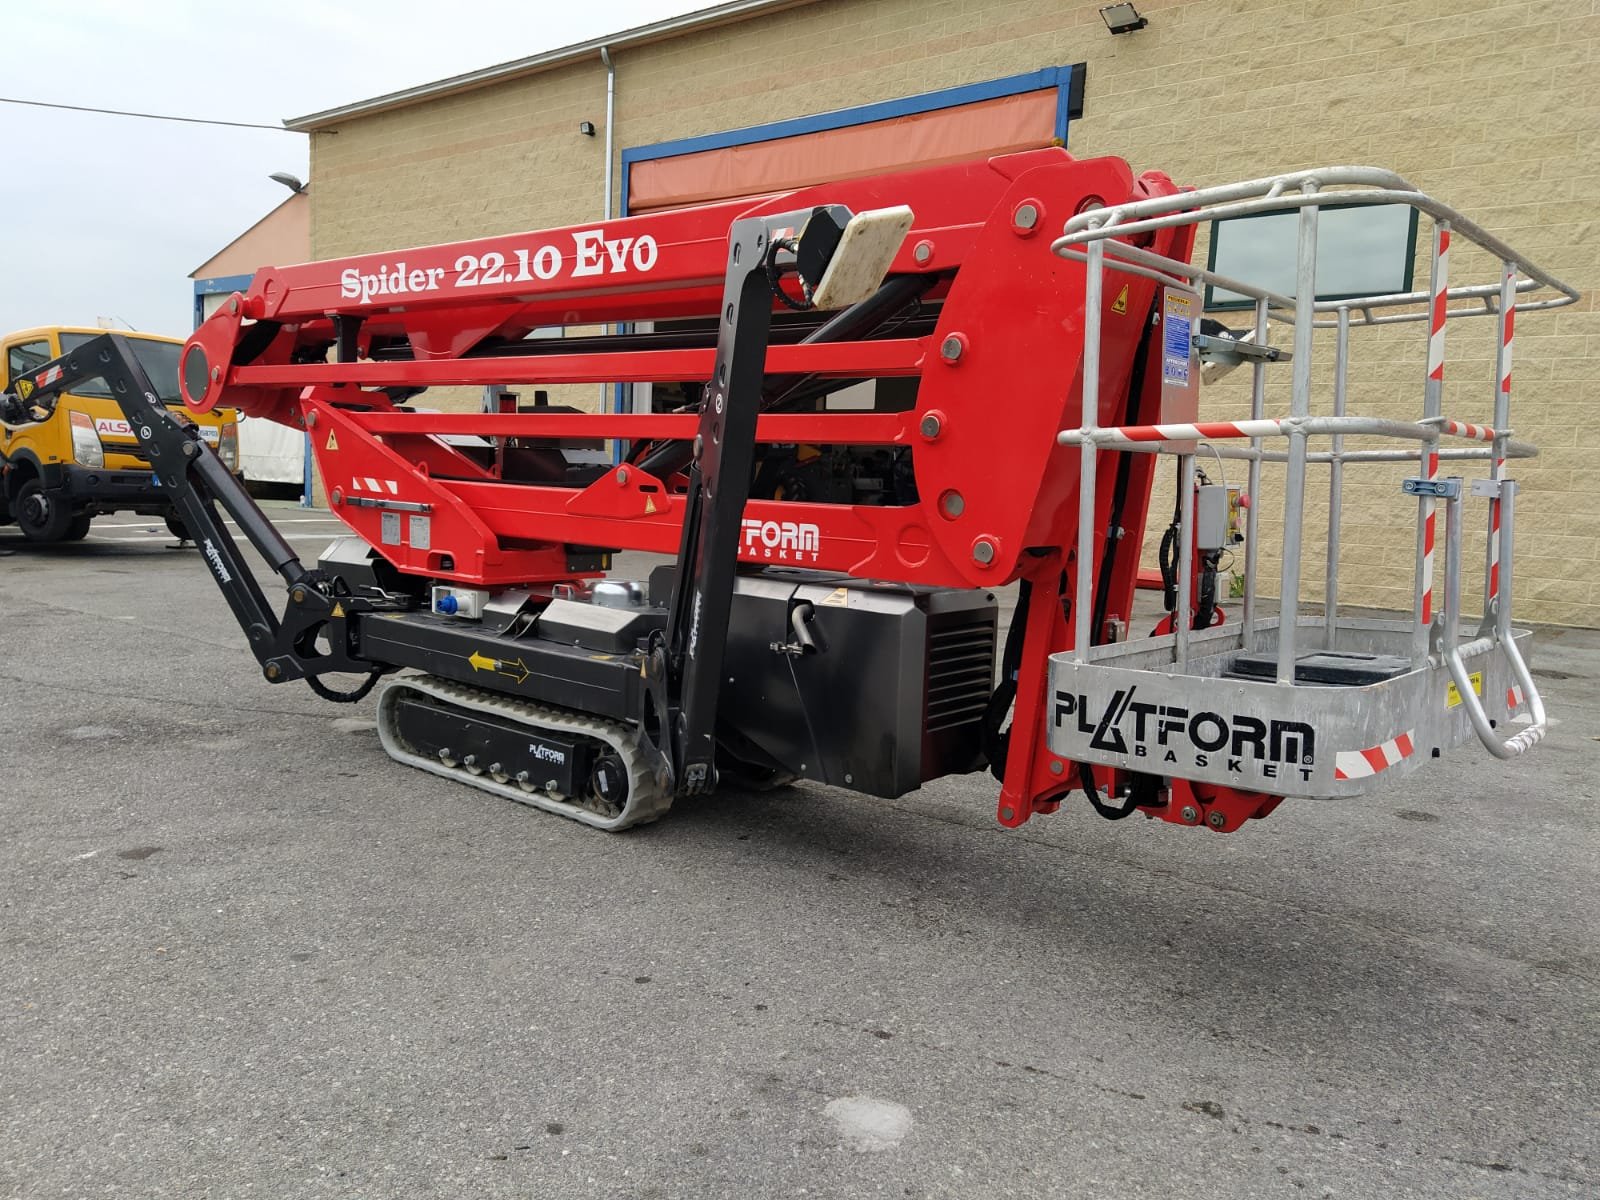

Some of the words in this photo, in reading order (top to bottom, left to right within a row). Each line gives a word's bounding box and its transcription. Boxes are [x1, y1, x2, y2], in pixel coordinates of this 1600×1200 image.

[341, 263, 444, 304] Spider
[454, 245, 562, 287] 22.10
[571, 229, 658, 278] Evo
[741, 519, 819, 551] FORM
[1055, 685, 1315, 765] PLATFORM
[1135, 745, 1313, 782] BASKET
